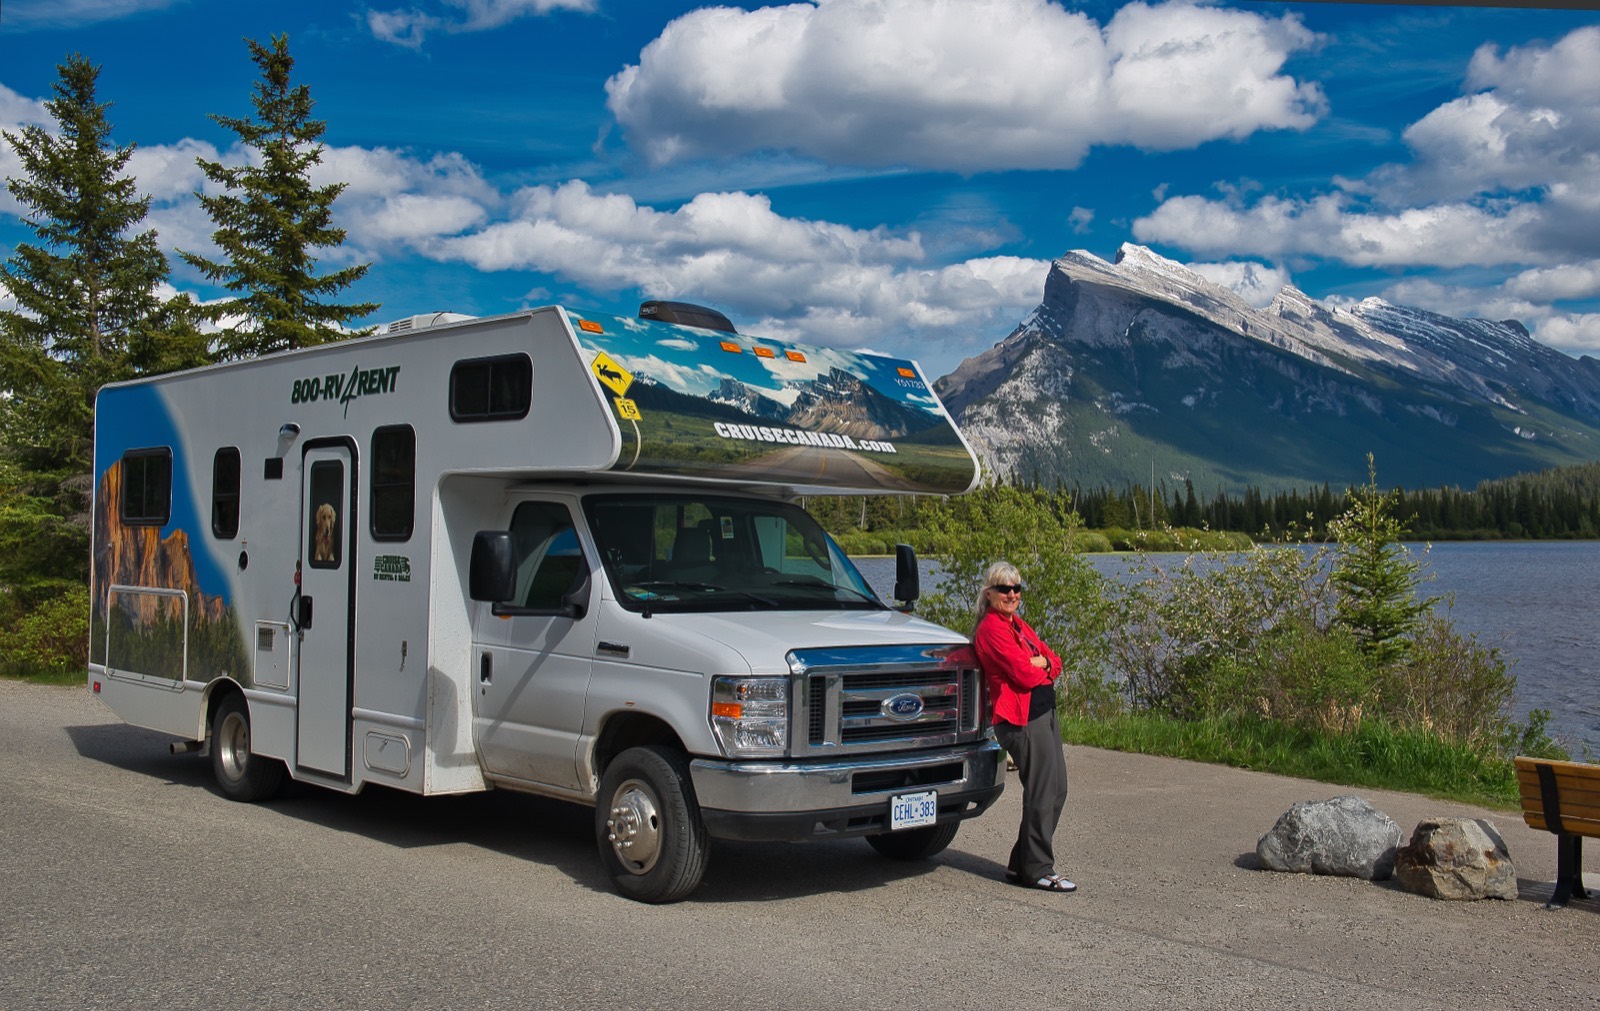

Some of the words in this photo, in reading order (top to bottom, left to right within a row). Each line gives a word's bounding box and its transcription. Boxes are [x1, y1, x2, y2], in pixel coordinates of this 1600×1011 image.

[713, 421, 897, 453] CRUISECANADA.com
[894, 803, 915, 821] CEHL
[919, 800, 935, 818] 383
